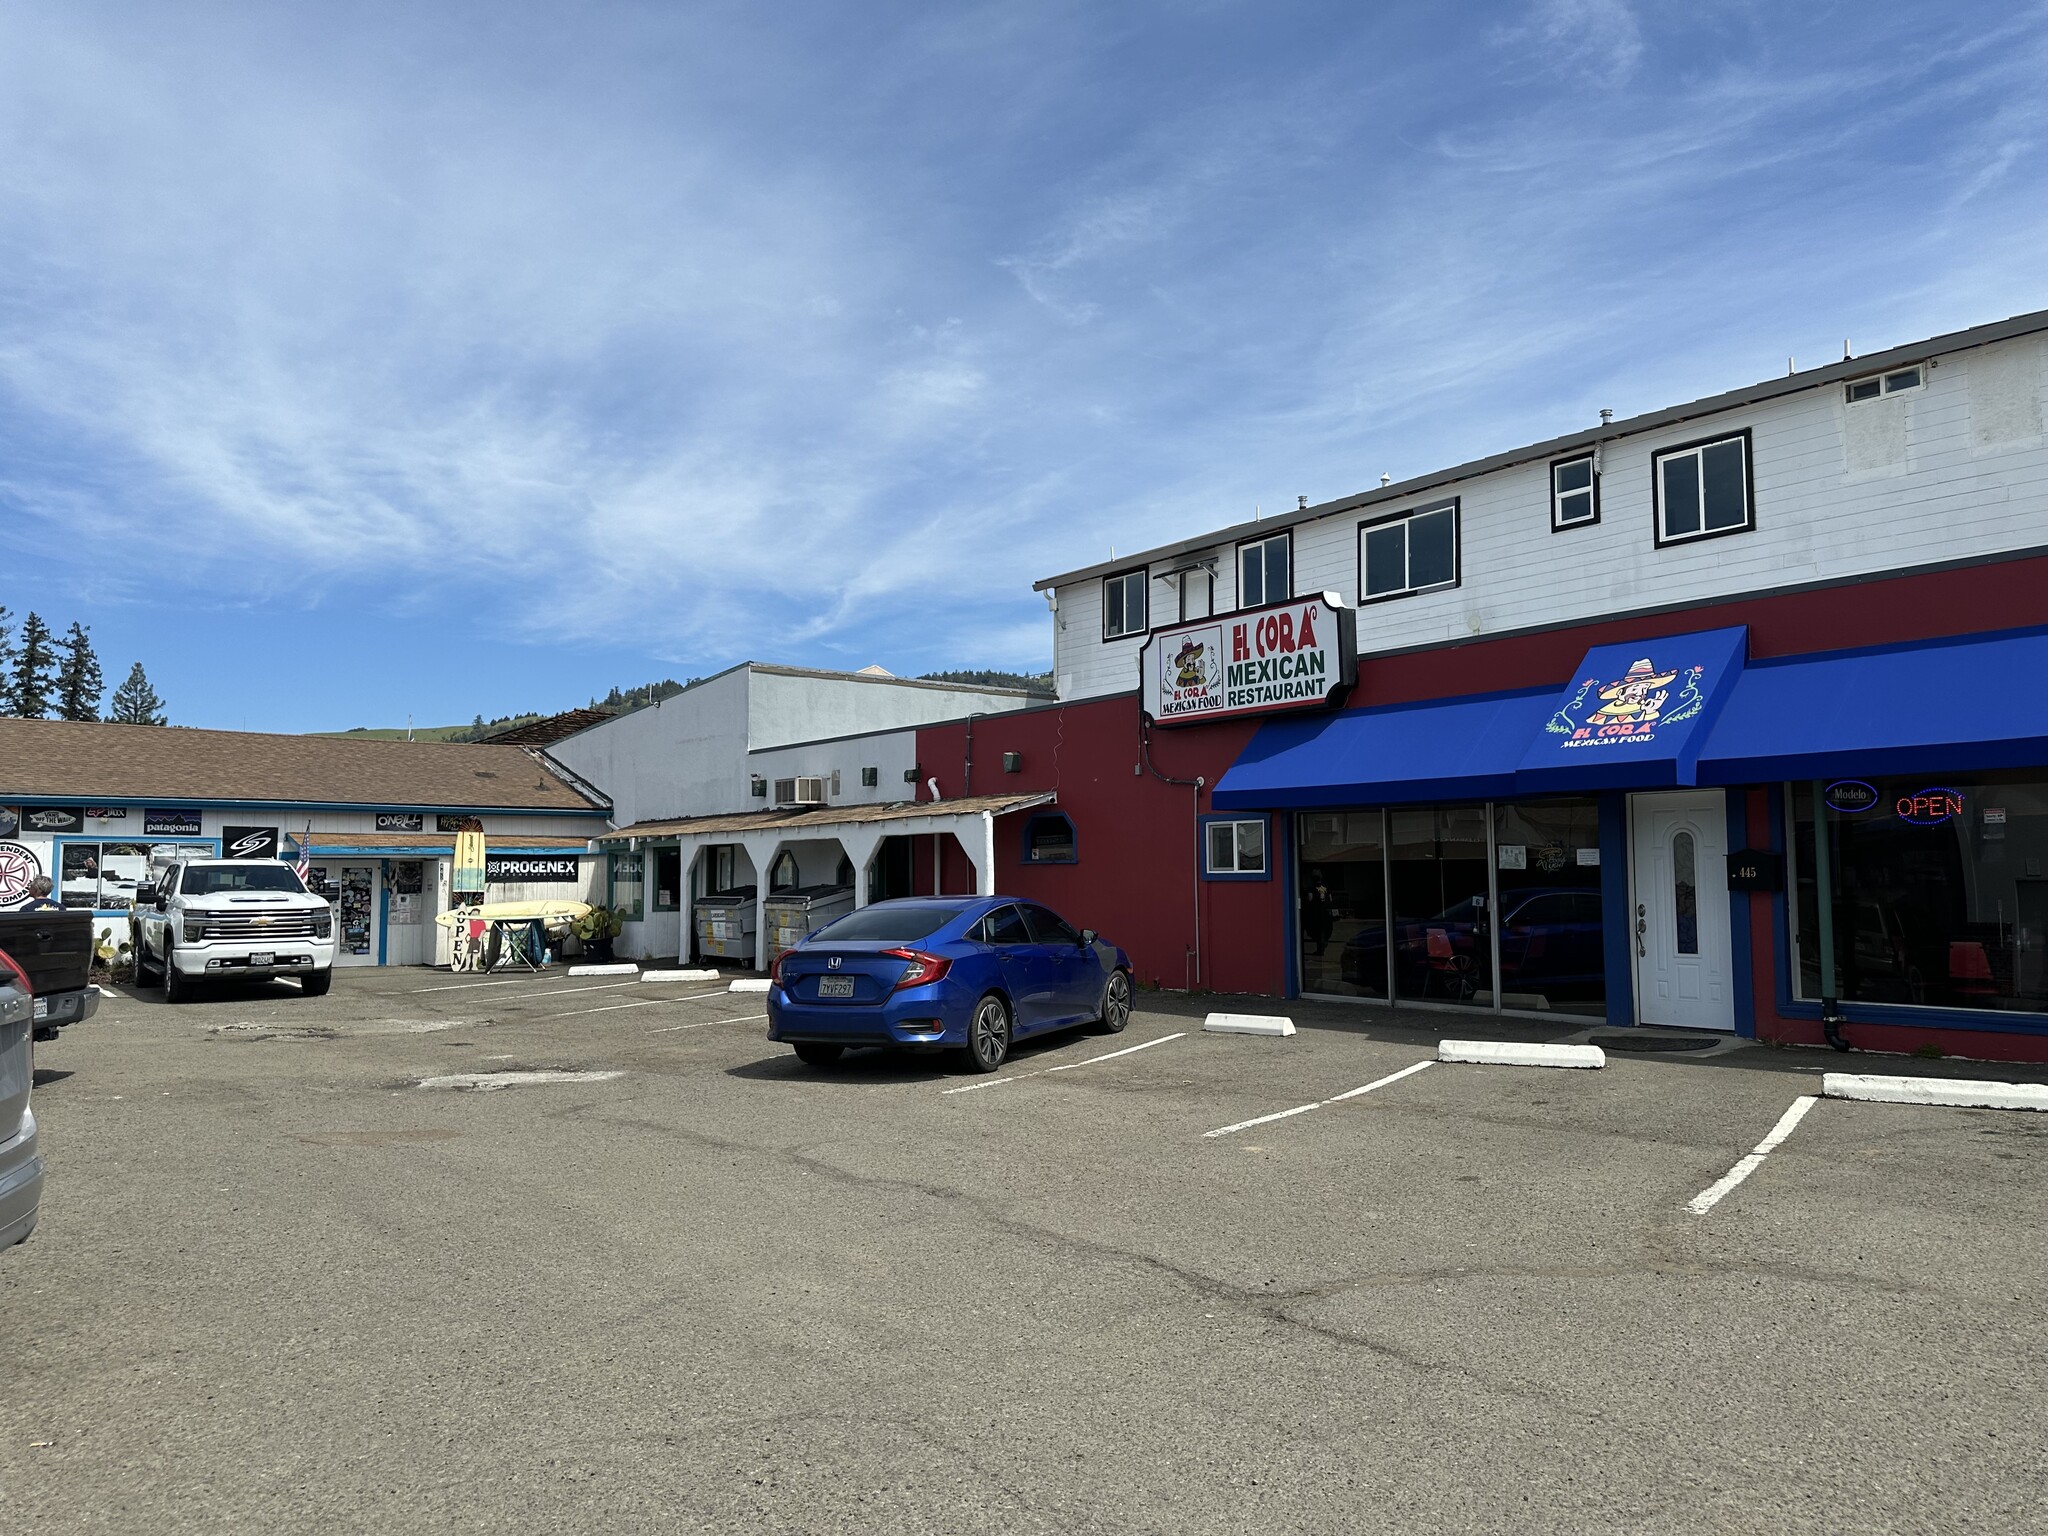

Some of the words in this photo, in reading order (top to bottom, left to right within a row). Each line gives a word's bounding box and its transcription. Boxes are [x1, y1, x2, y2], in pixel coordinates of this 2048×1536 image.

[1232, 622, 1250, 662] EL
[1227, 650, 1325, 688] MEXICAN
[1174, 690, 1182, 701] EL
[1227, 678, 1326, 707] RESTAURANT
[1163, 699, 1197, 714] MEXICAN
[1198, 694, 1222, 709] FOOD
[1572, 728, 1591, 739] EL
[1560, 738, 1617, 748] MEXICAN
[1619, 734, 1654, 743] FOOD
[1834, 788, 1867, 800] Modelo
[1896, 795, 1963, 816] OPEN
[146, 823, 199, 833] patagonia
[500, 861, 576, 873] PROGENEX
[1739, 866, 1757, 878] 445
[453, 911, 466, 966] OPEN
[822, 983, 852, 995] 7YVF297
